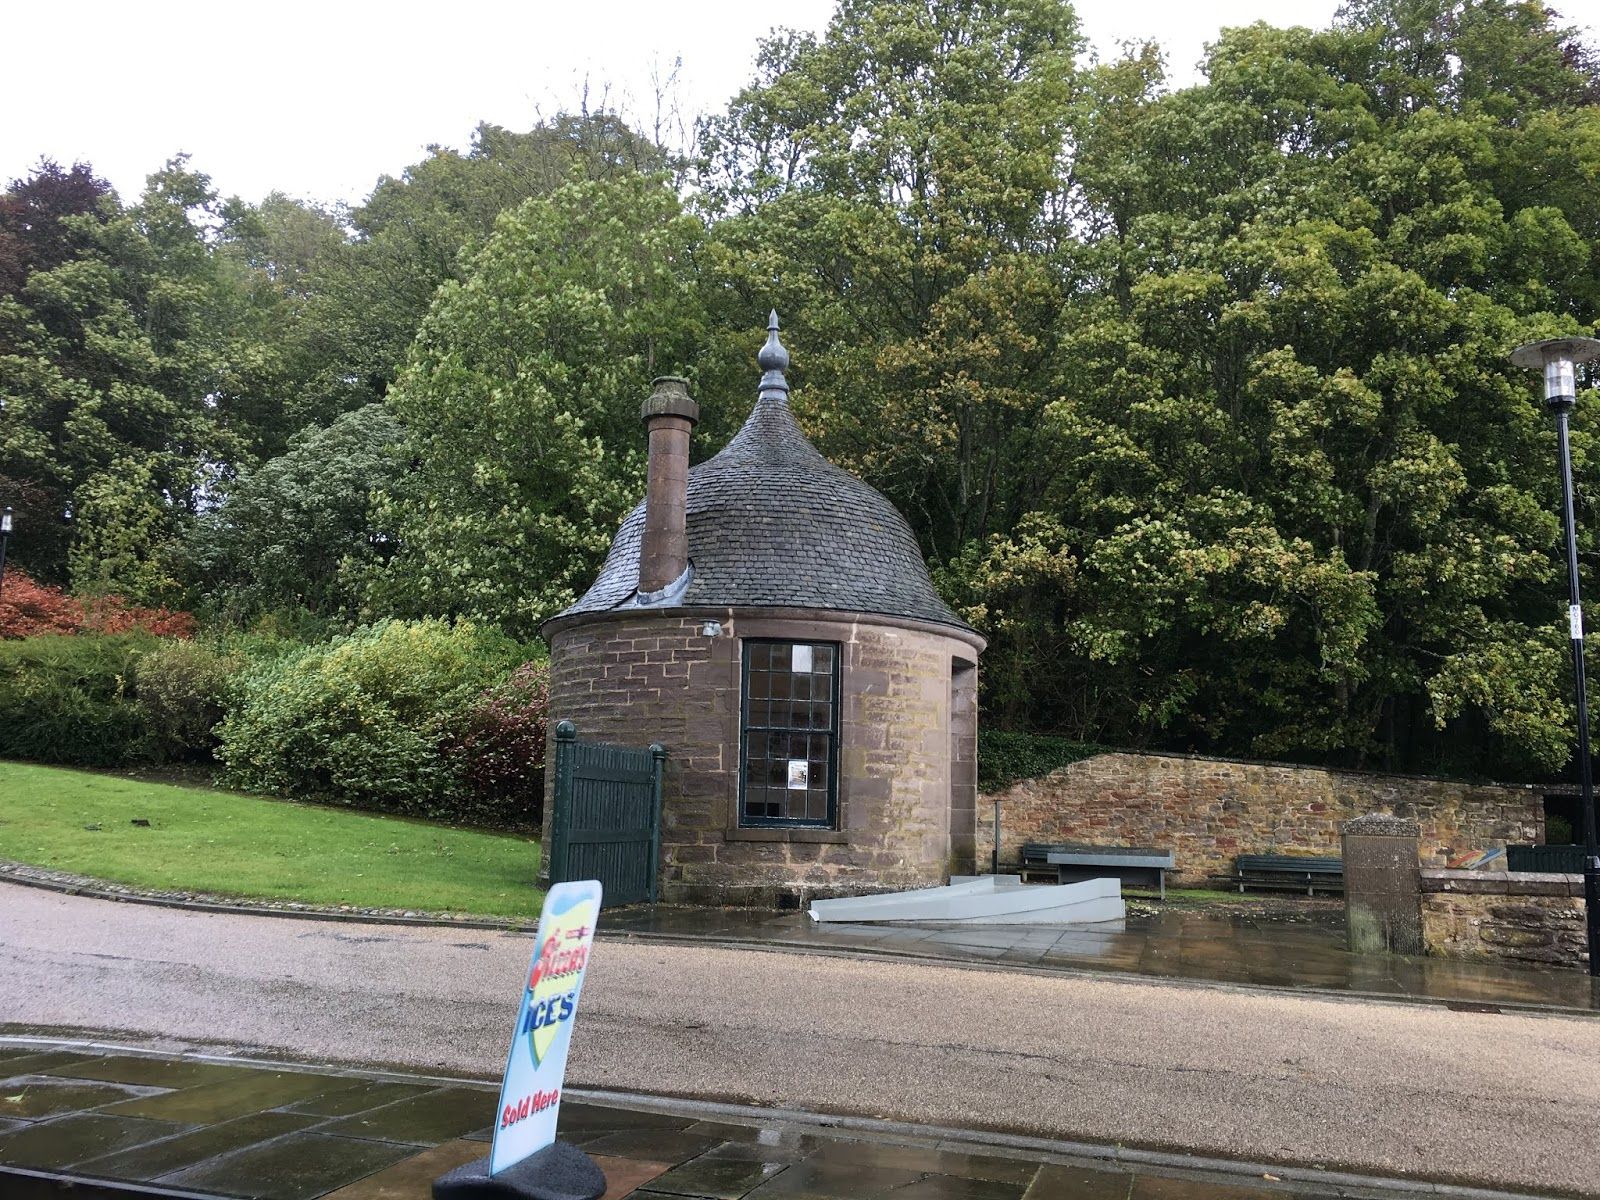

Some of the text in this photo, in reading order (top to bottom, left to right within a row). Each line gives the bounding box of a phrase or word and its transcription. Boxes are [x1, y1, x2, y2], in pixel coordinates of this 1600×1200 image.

[522, 994, 574, 1034] ICES
[501, 1089, 559, 1129] Sold Here
